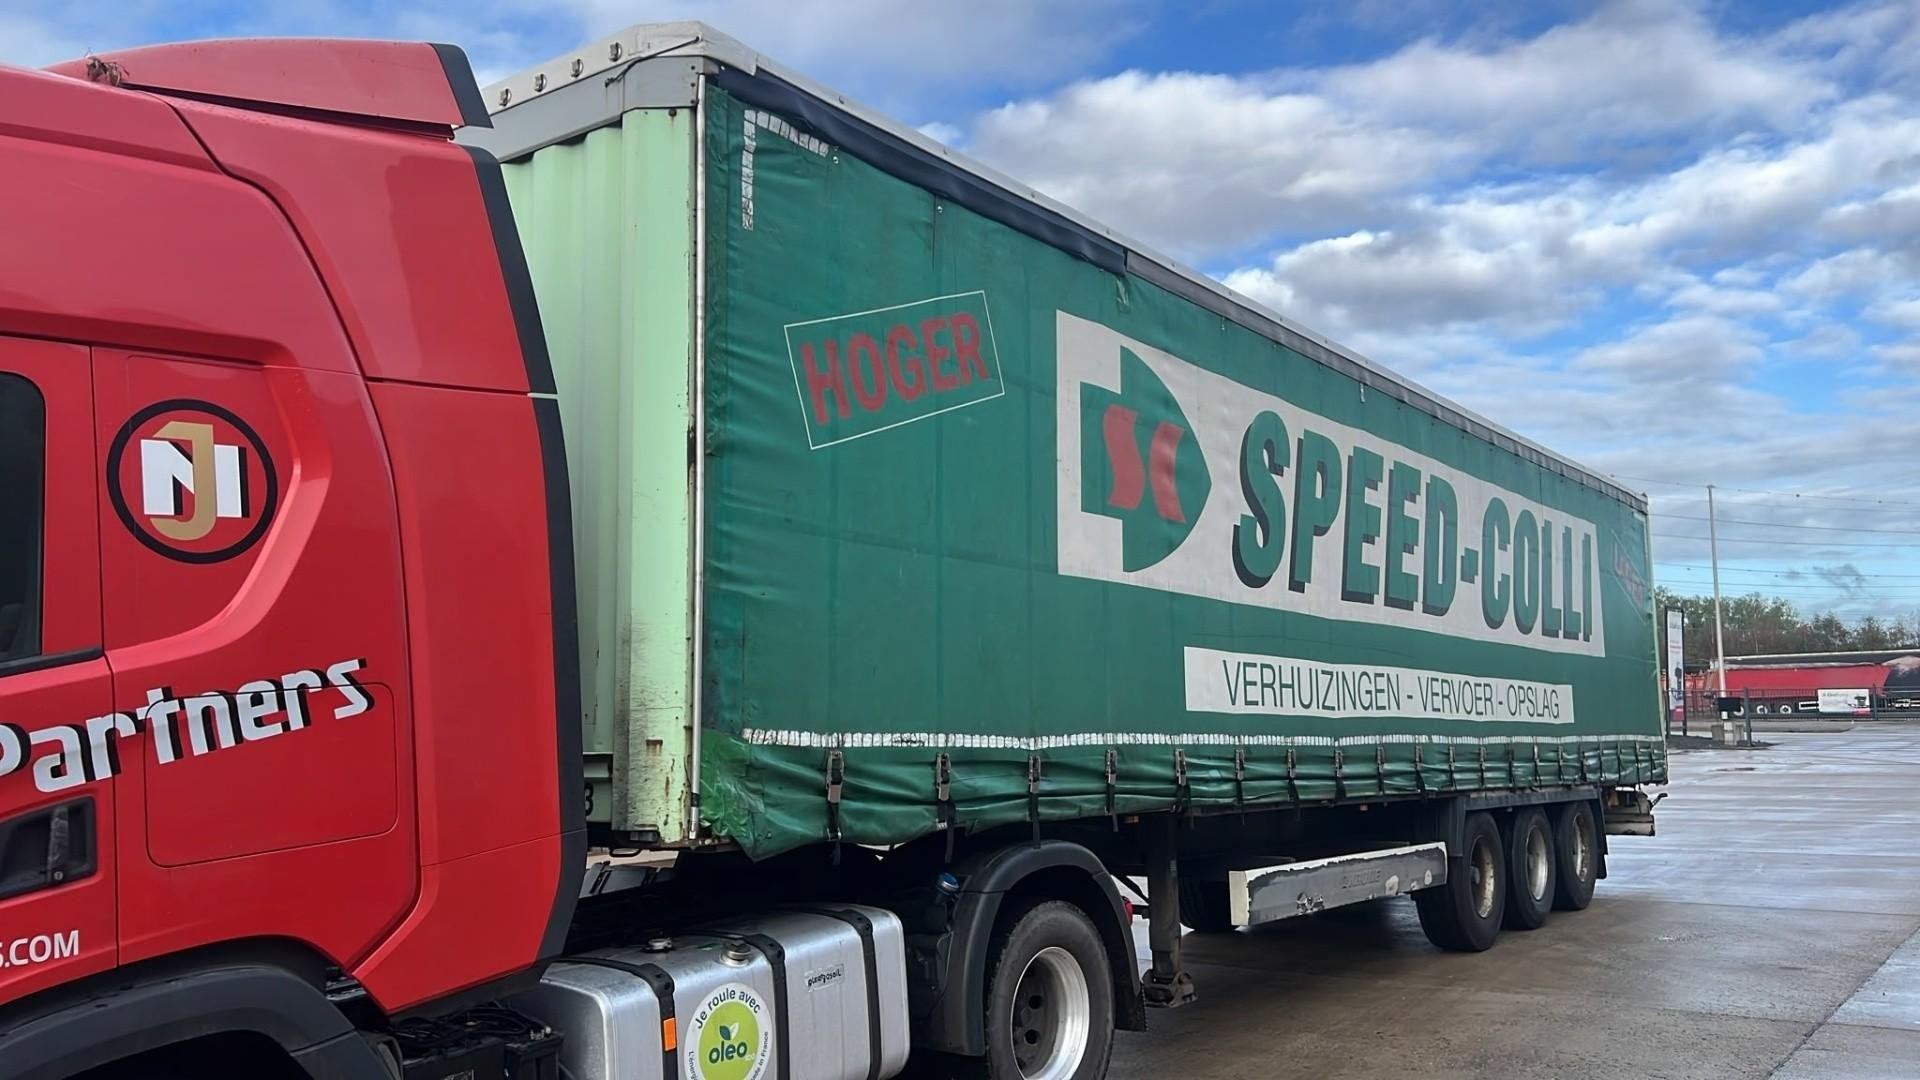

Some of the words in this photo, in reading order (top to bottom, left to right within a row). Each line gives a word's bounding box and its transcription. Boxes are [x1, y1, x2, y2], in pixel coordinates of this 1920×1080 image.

[801, 312, 990, 425] HOGER
[1232, 410, 1593, 642] SPEED-COLLI
[1222, 659, 1401, 712] VERHUIZINGEN
[1417, 675, 1495, 716] VERVOER
[1507, 684, 1560, 720] OPSLAG
[0, 929, 80, 969] .COM
[695, 1010, 708, 1029] Je
[708, 988, 736, 1011] roule
[739, 991, 761, 1014] avec
[708, 1041, 748, 1064] oleo
